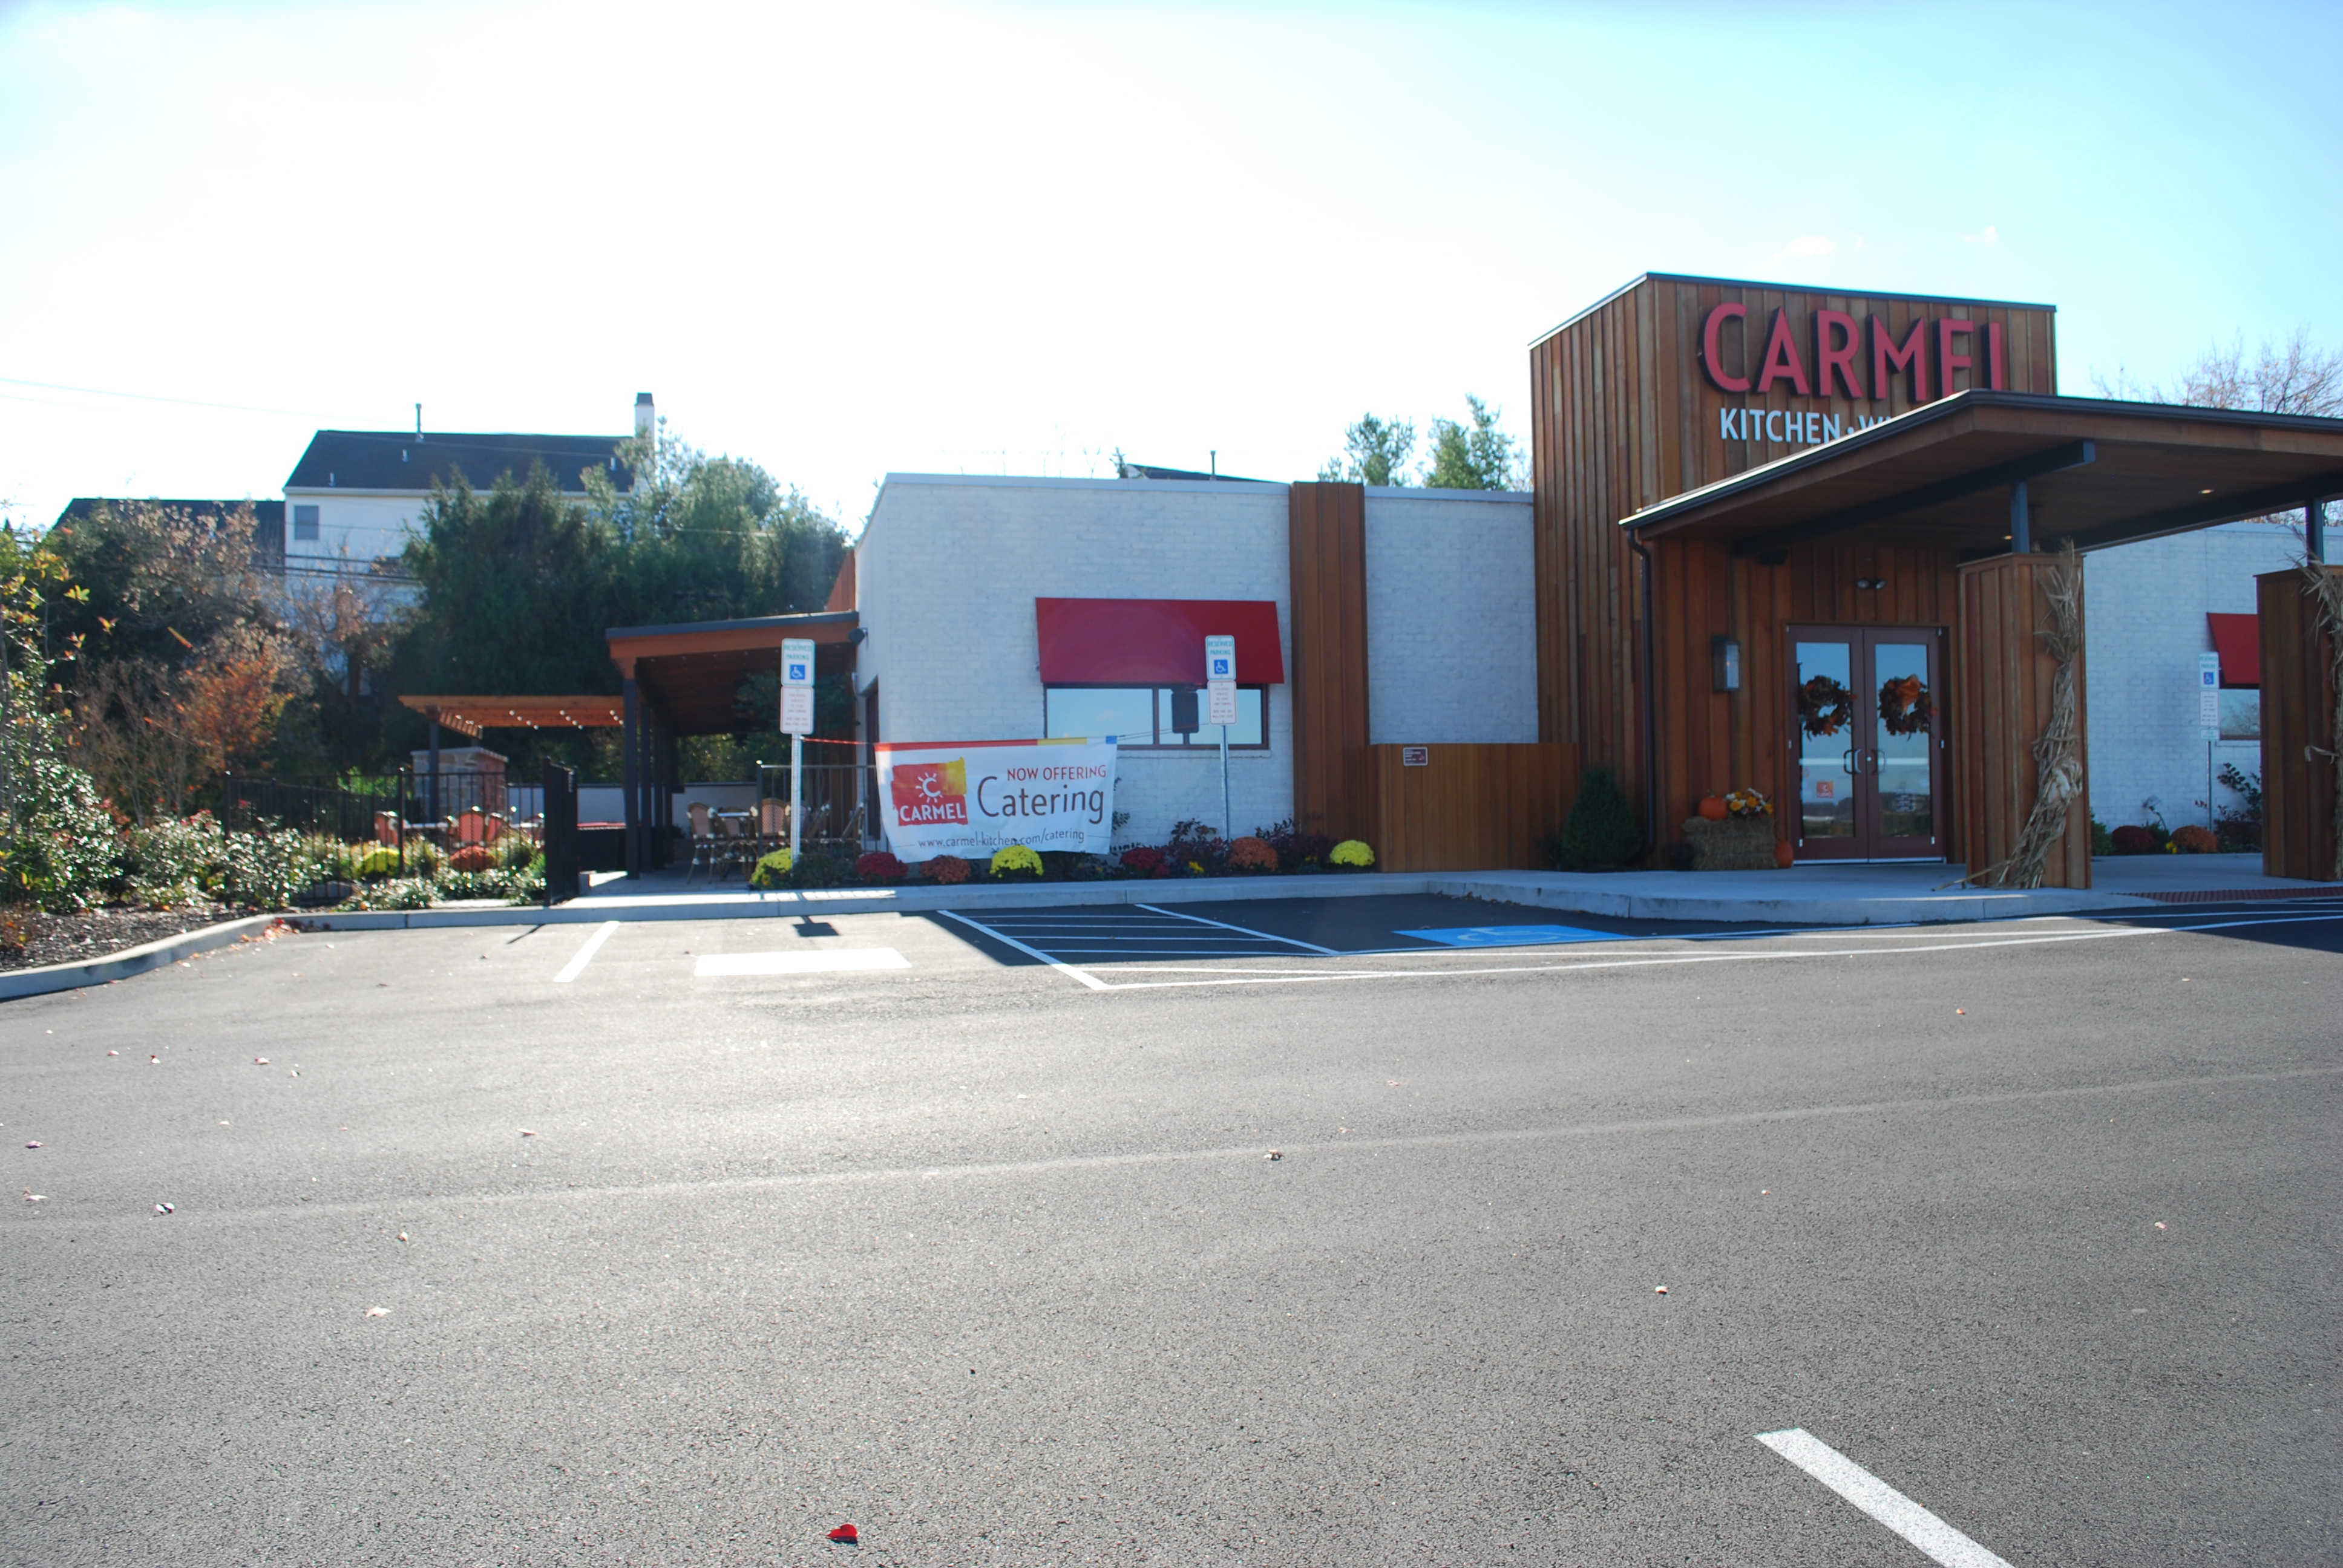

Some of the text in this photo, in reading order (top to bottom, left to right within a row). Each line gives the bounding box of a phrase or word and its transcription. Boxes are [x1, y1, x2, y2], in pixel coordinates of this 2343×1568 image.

[1720, 408, 1840, 443] KITCHEN
[1007, 765, 1107, 781] NOW OFFERING
[977, 776, 1104, 824] Catering
[900, 803, 966, 822] CARMEL
[918, 828, 1084, 847] www.carmel-kitchen.com/catering
